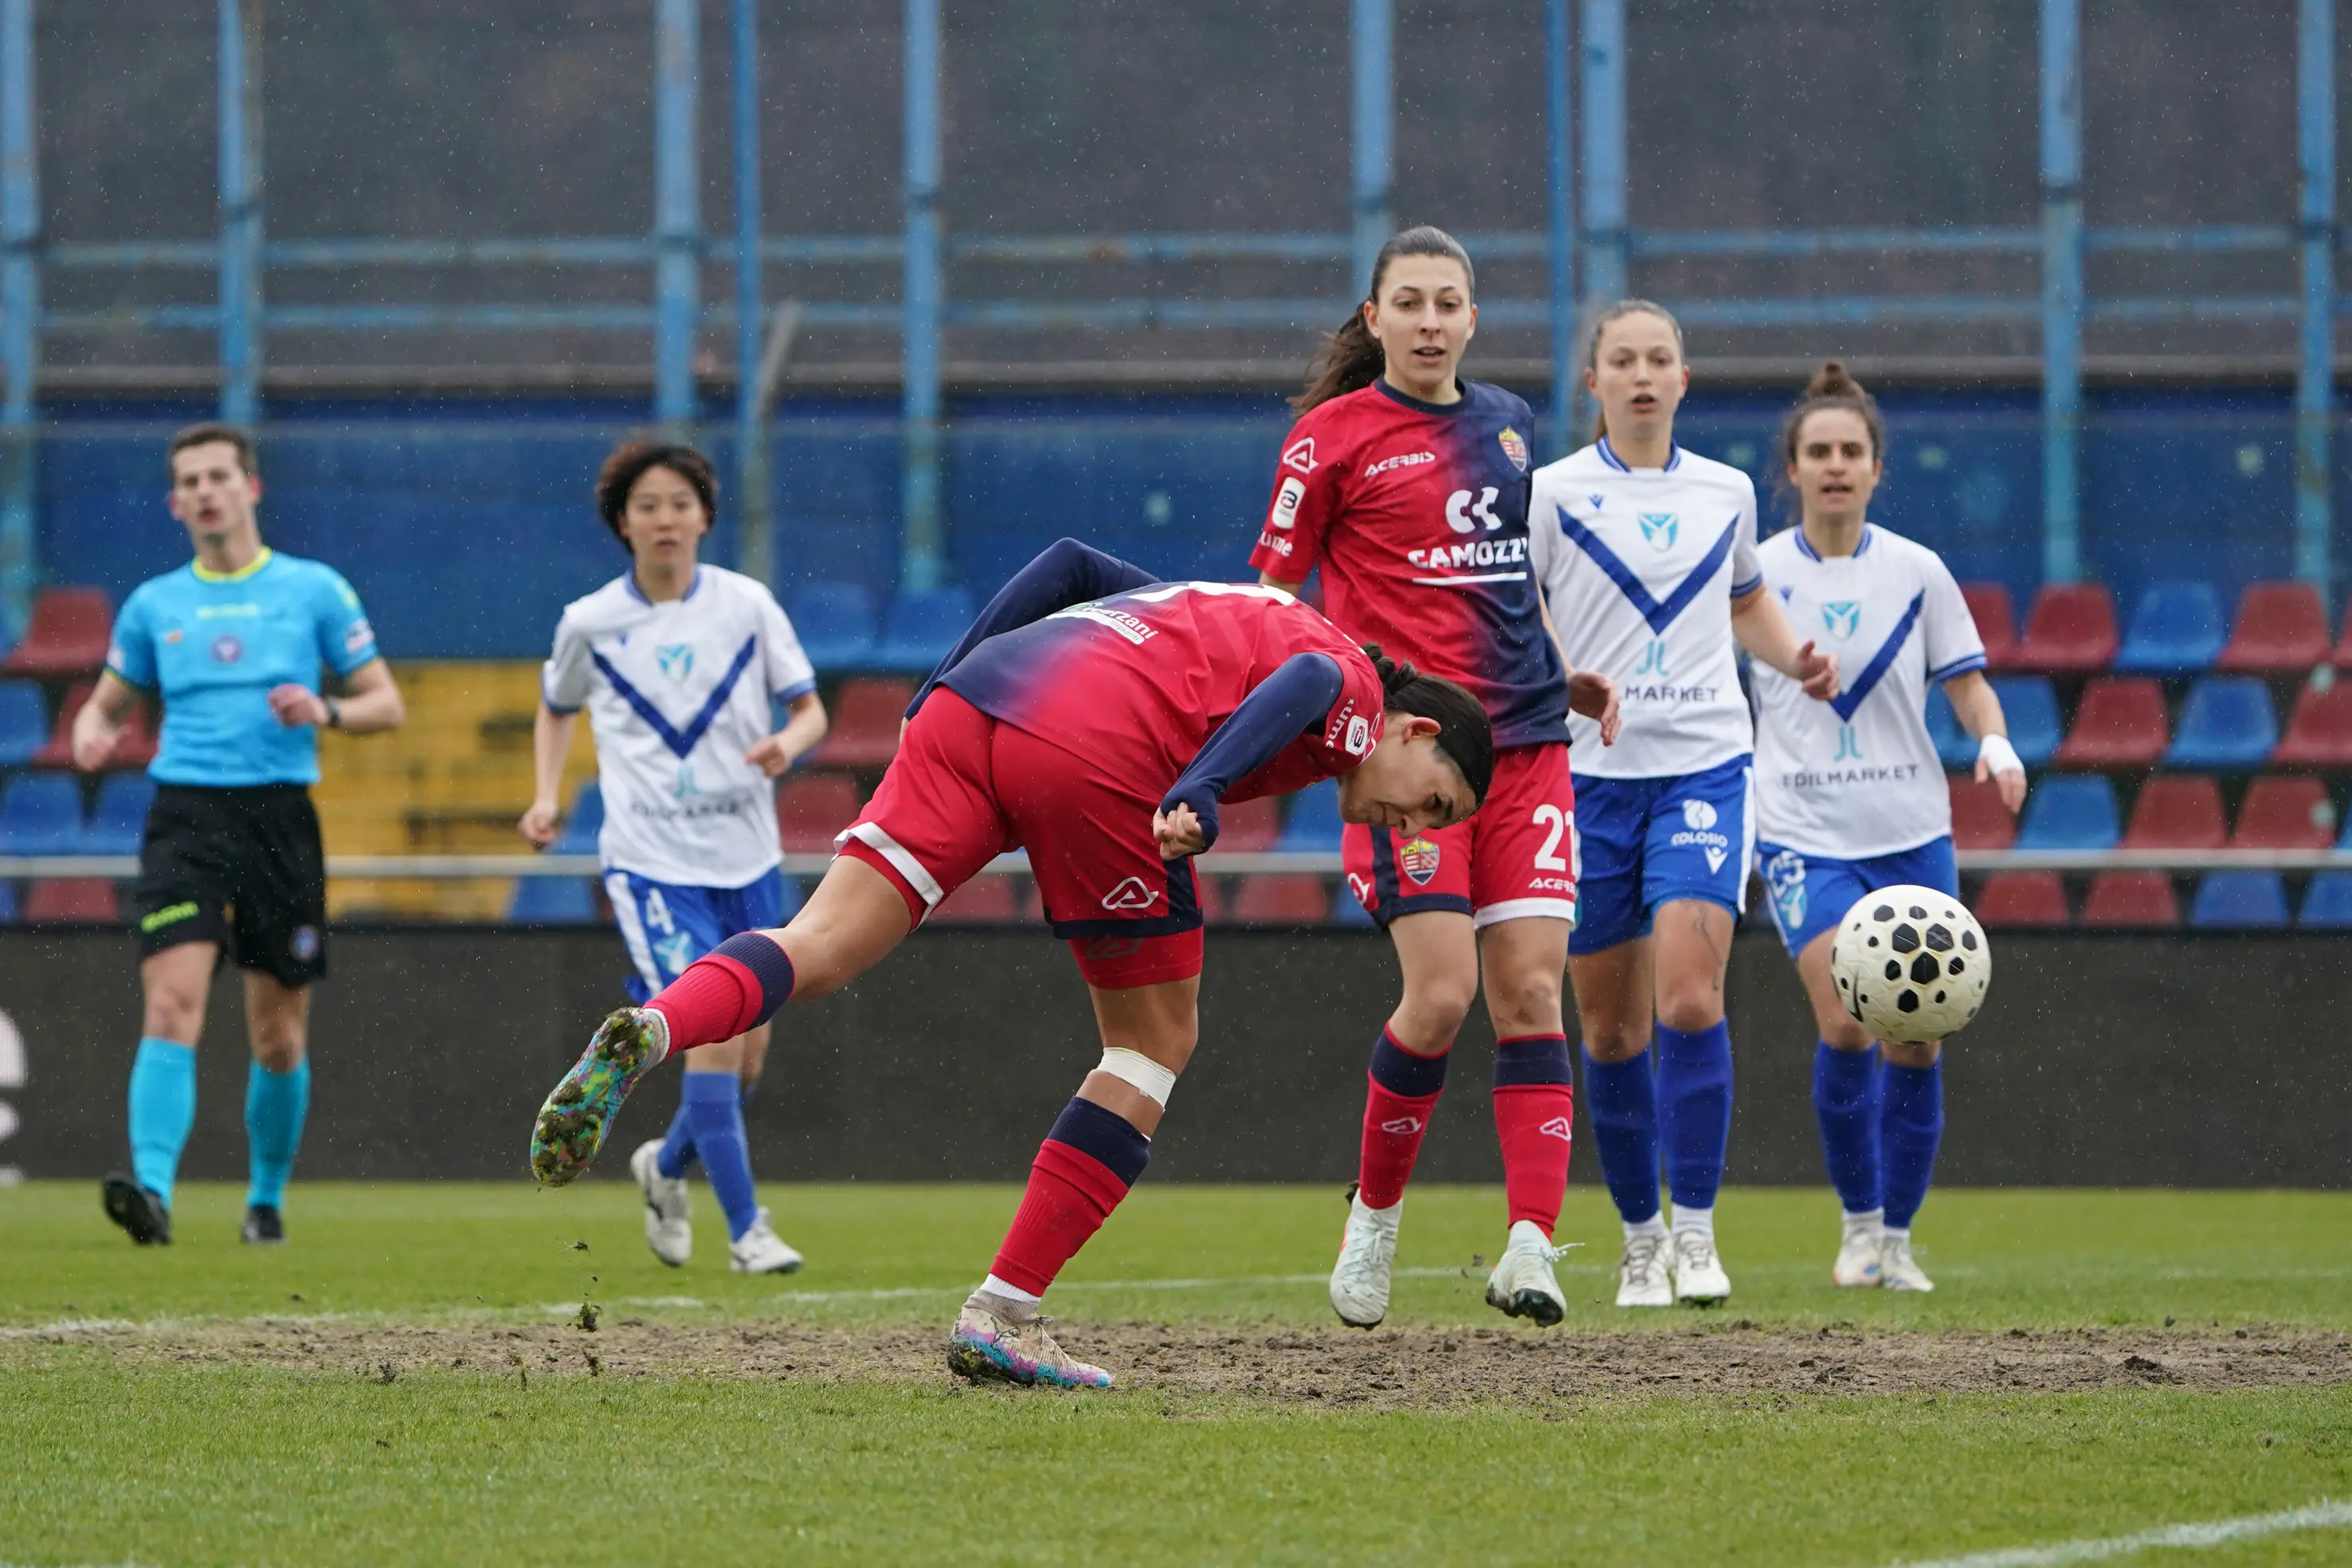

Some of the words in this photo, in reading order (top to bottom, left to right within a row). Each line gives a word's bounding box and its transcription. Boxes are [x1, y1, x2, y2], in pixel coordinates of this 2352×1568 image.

[1365, 451, 1436, 477] ACERBIS
[1625, 685, 1719, 702] MARKET
[1782, 764, 1919, 788] EDILMARKET
[1532, 804, 1576, 877] 21
[646, 887, 675, 935] 4
